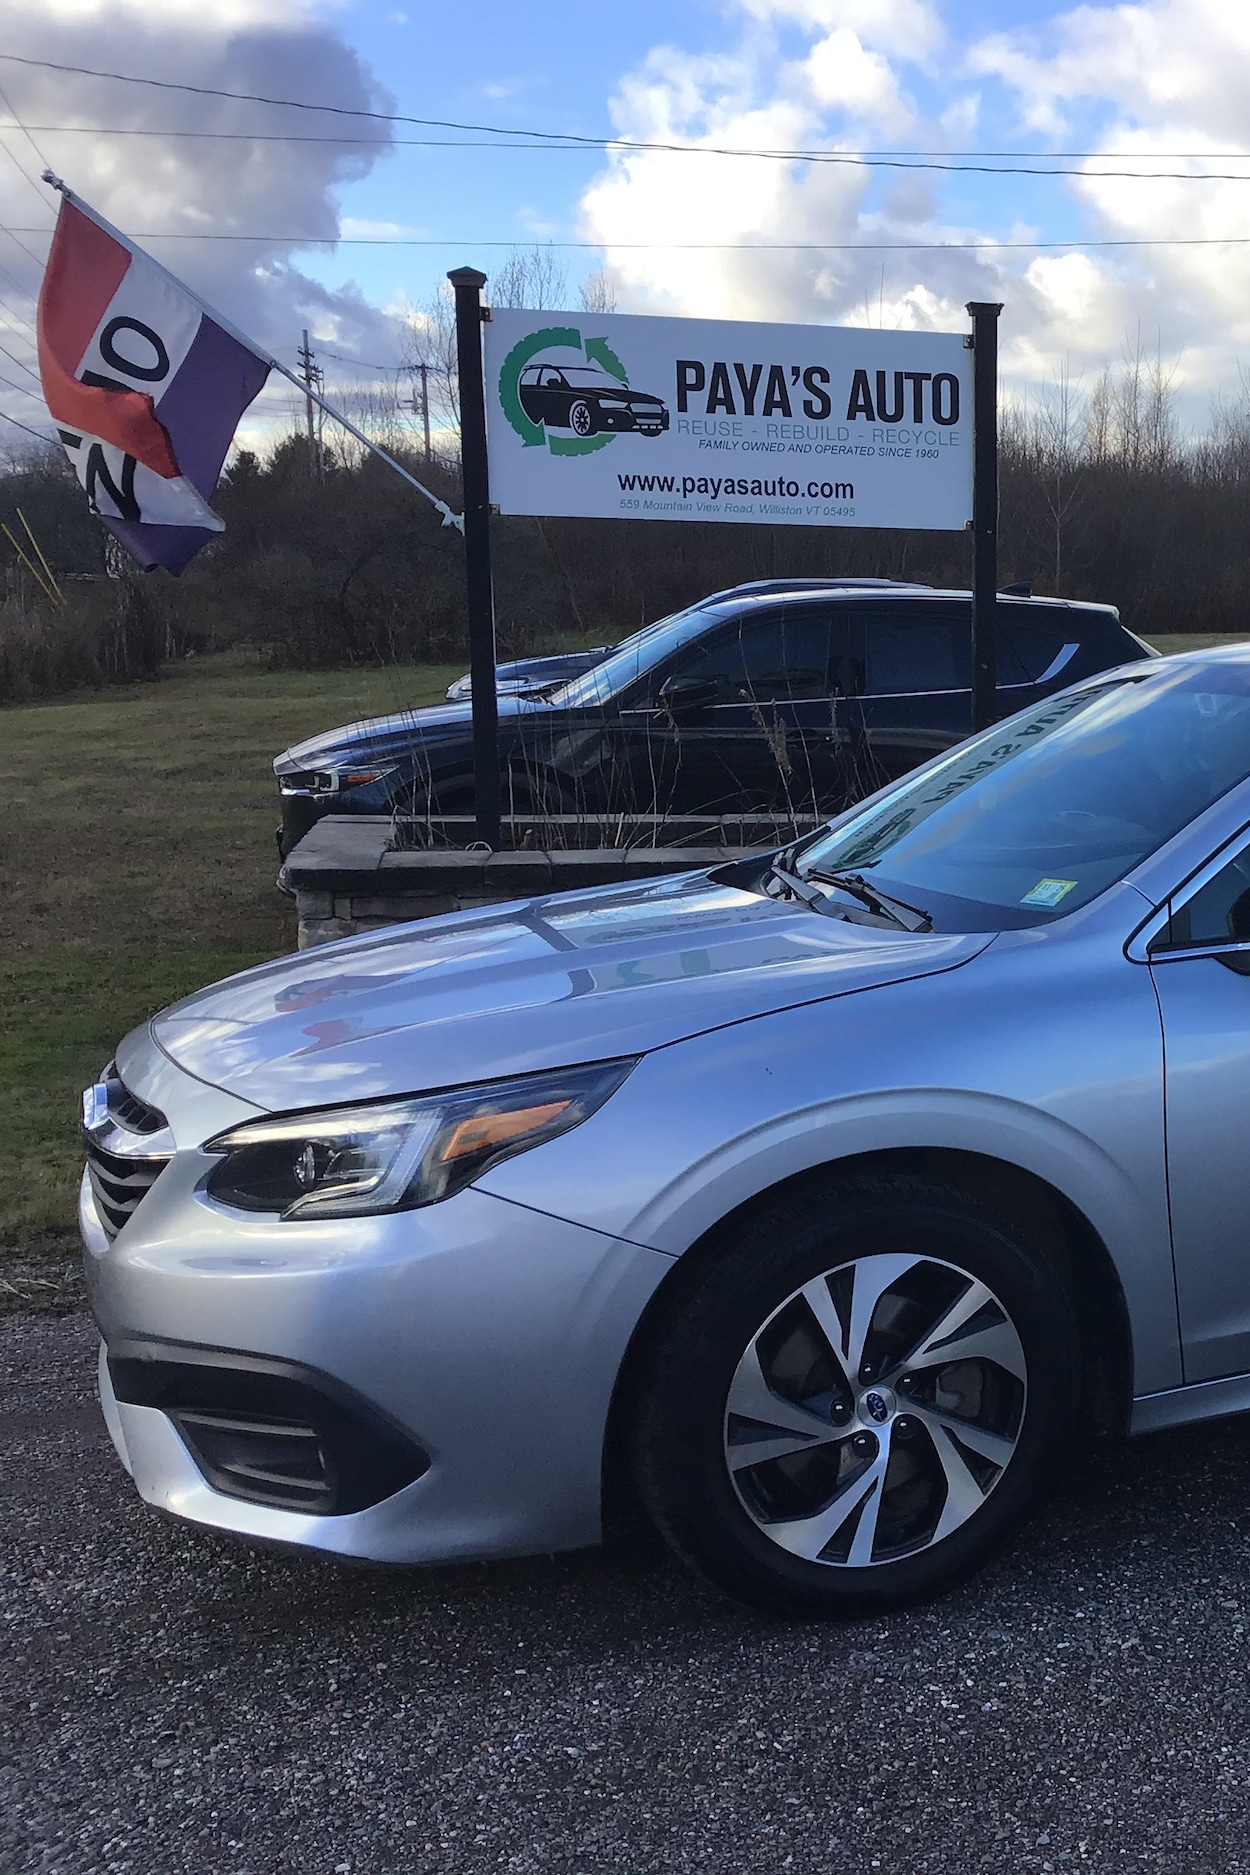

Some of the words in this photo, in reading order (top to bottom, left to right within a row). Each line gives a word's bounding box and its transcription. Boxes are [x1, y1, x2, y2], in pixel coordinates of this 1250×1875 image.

[676, 360, 831, 420] PAYA'S
[846, 369, 959, 426] AUTO
[677, 419, 743, 437] REUSE
[766, 423, 850, 442] REBUILD
[872, 428, 960, 446] RECYCLE
[698, 439, 739, 450] FAMILY
[741, 441, 785, 453] OWNED
[787, 443, 812, 454] AND
[814, 444, 875, 456] OPERATED
[878, 447, 912, 458] SINCE
[915, 449, 939, 459] 1960
[617, 474, 854, 500] www.payasauto.com
[619, 499, 640, 509] 559
[643, 500, 692, 511] Mountain
[697, 502, 721, 512] View
[724, 502, 755, 515] Road,
[759, 504, 802, 515] Williston
[806, 506, 821, 516] VT
[823, 506, 856, 517] 05495
